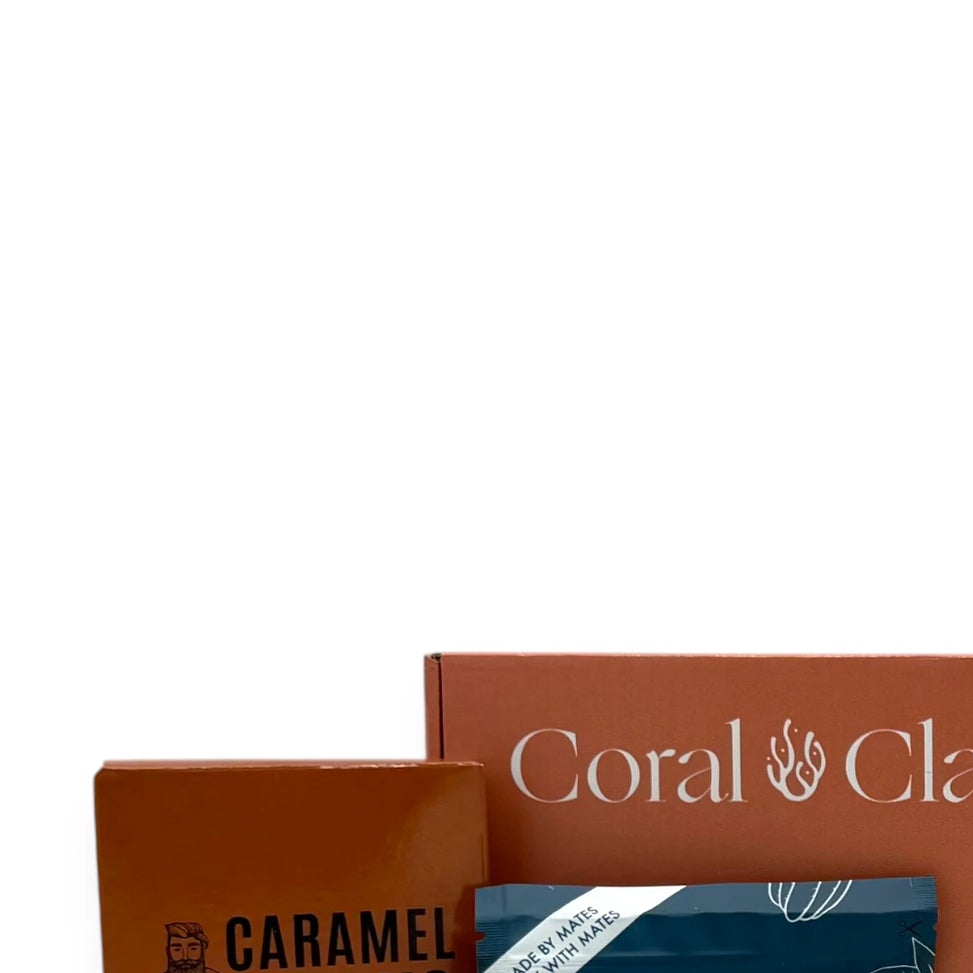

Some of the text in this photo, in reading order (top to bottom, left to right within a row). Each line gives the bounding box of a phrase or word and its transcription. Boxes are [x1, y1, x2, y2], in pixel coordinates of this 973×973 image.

[510, 718, 748, 804] Coral
[225, 907, 456, 971] CARAMEL
[538, 936, 556, 955] BY
[555, 906, 599, 941] MATES
[543, 943, 579, 973] WITH
[577, 910, 621, 947] MATES
